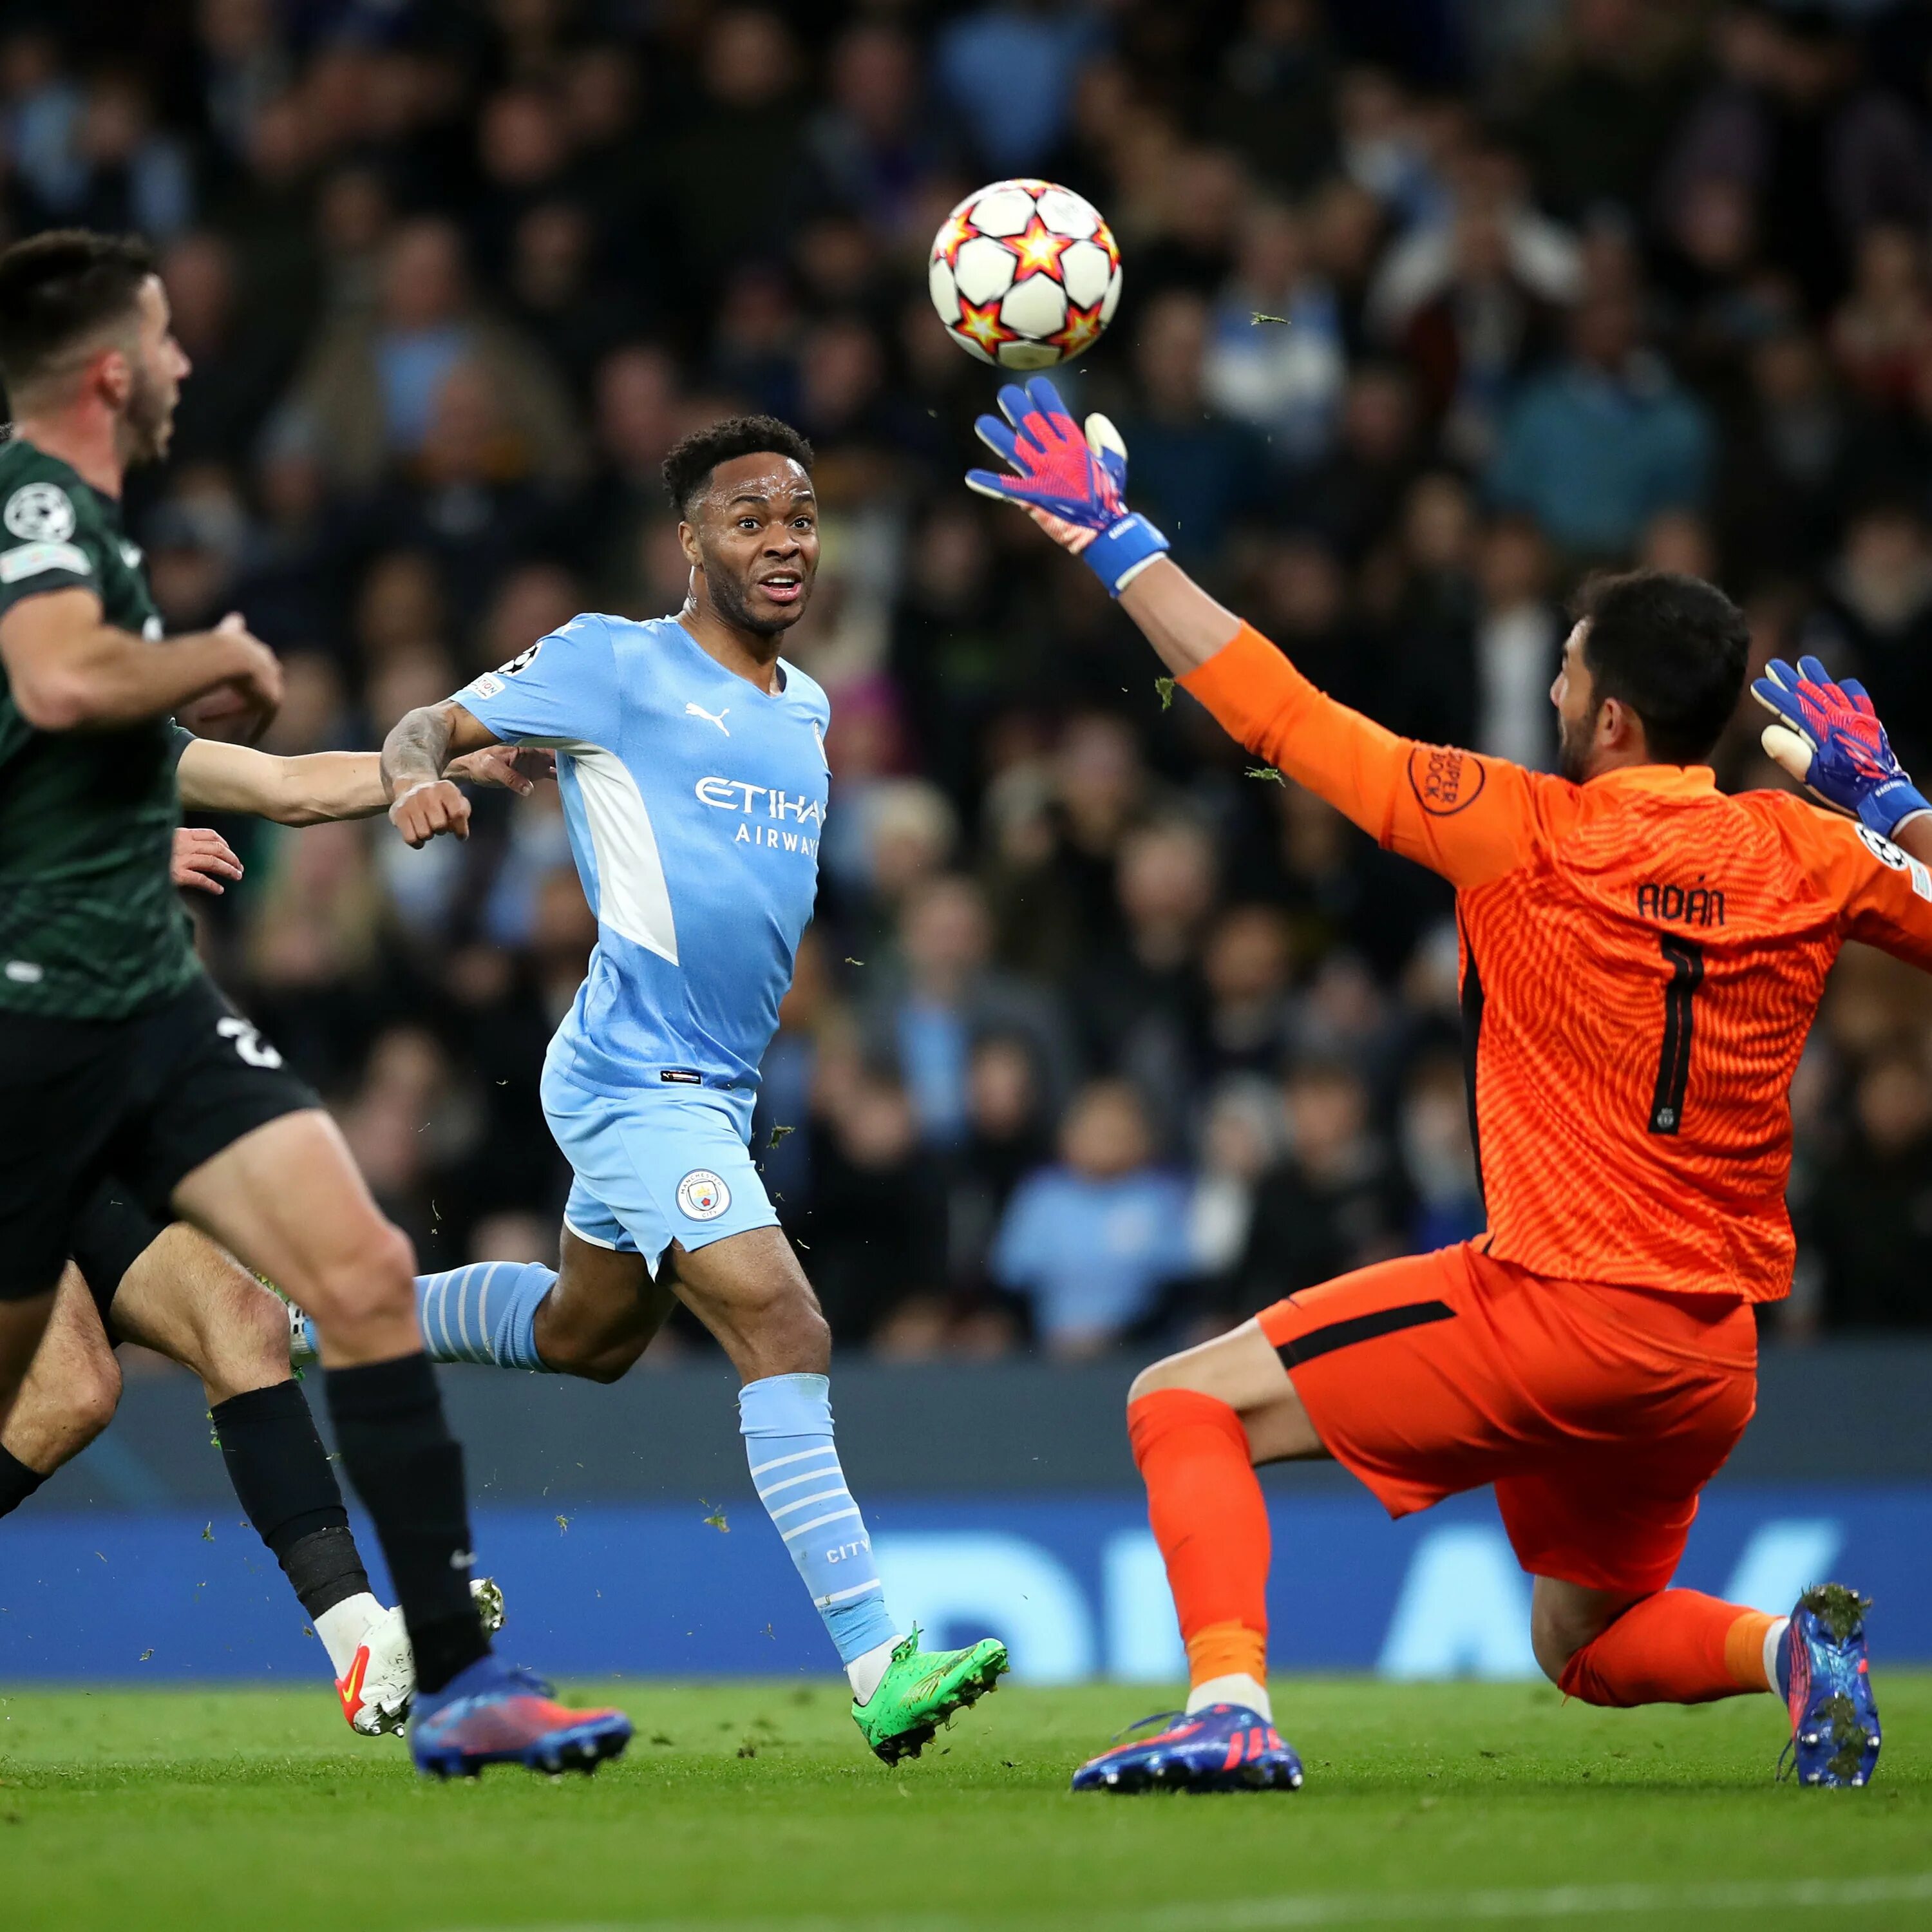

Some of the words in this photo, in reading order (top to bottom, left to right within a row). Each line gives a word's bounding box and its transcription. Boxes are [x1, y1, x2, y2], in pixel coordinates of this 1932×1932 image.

[1424, 752, 1445, 799] BOCK
[1638, 874, 1724, 926] ADÁN
[1648, 933, 1703, 1135] 1
[681, 1173, 722, 1194] MANCHESTER
[826, 1539, 869, 1564] CITY
